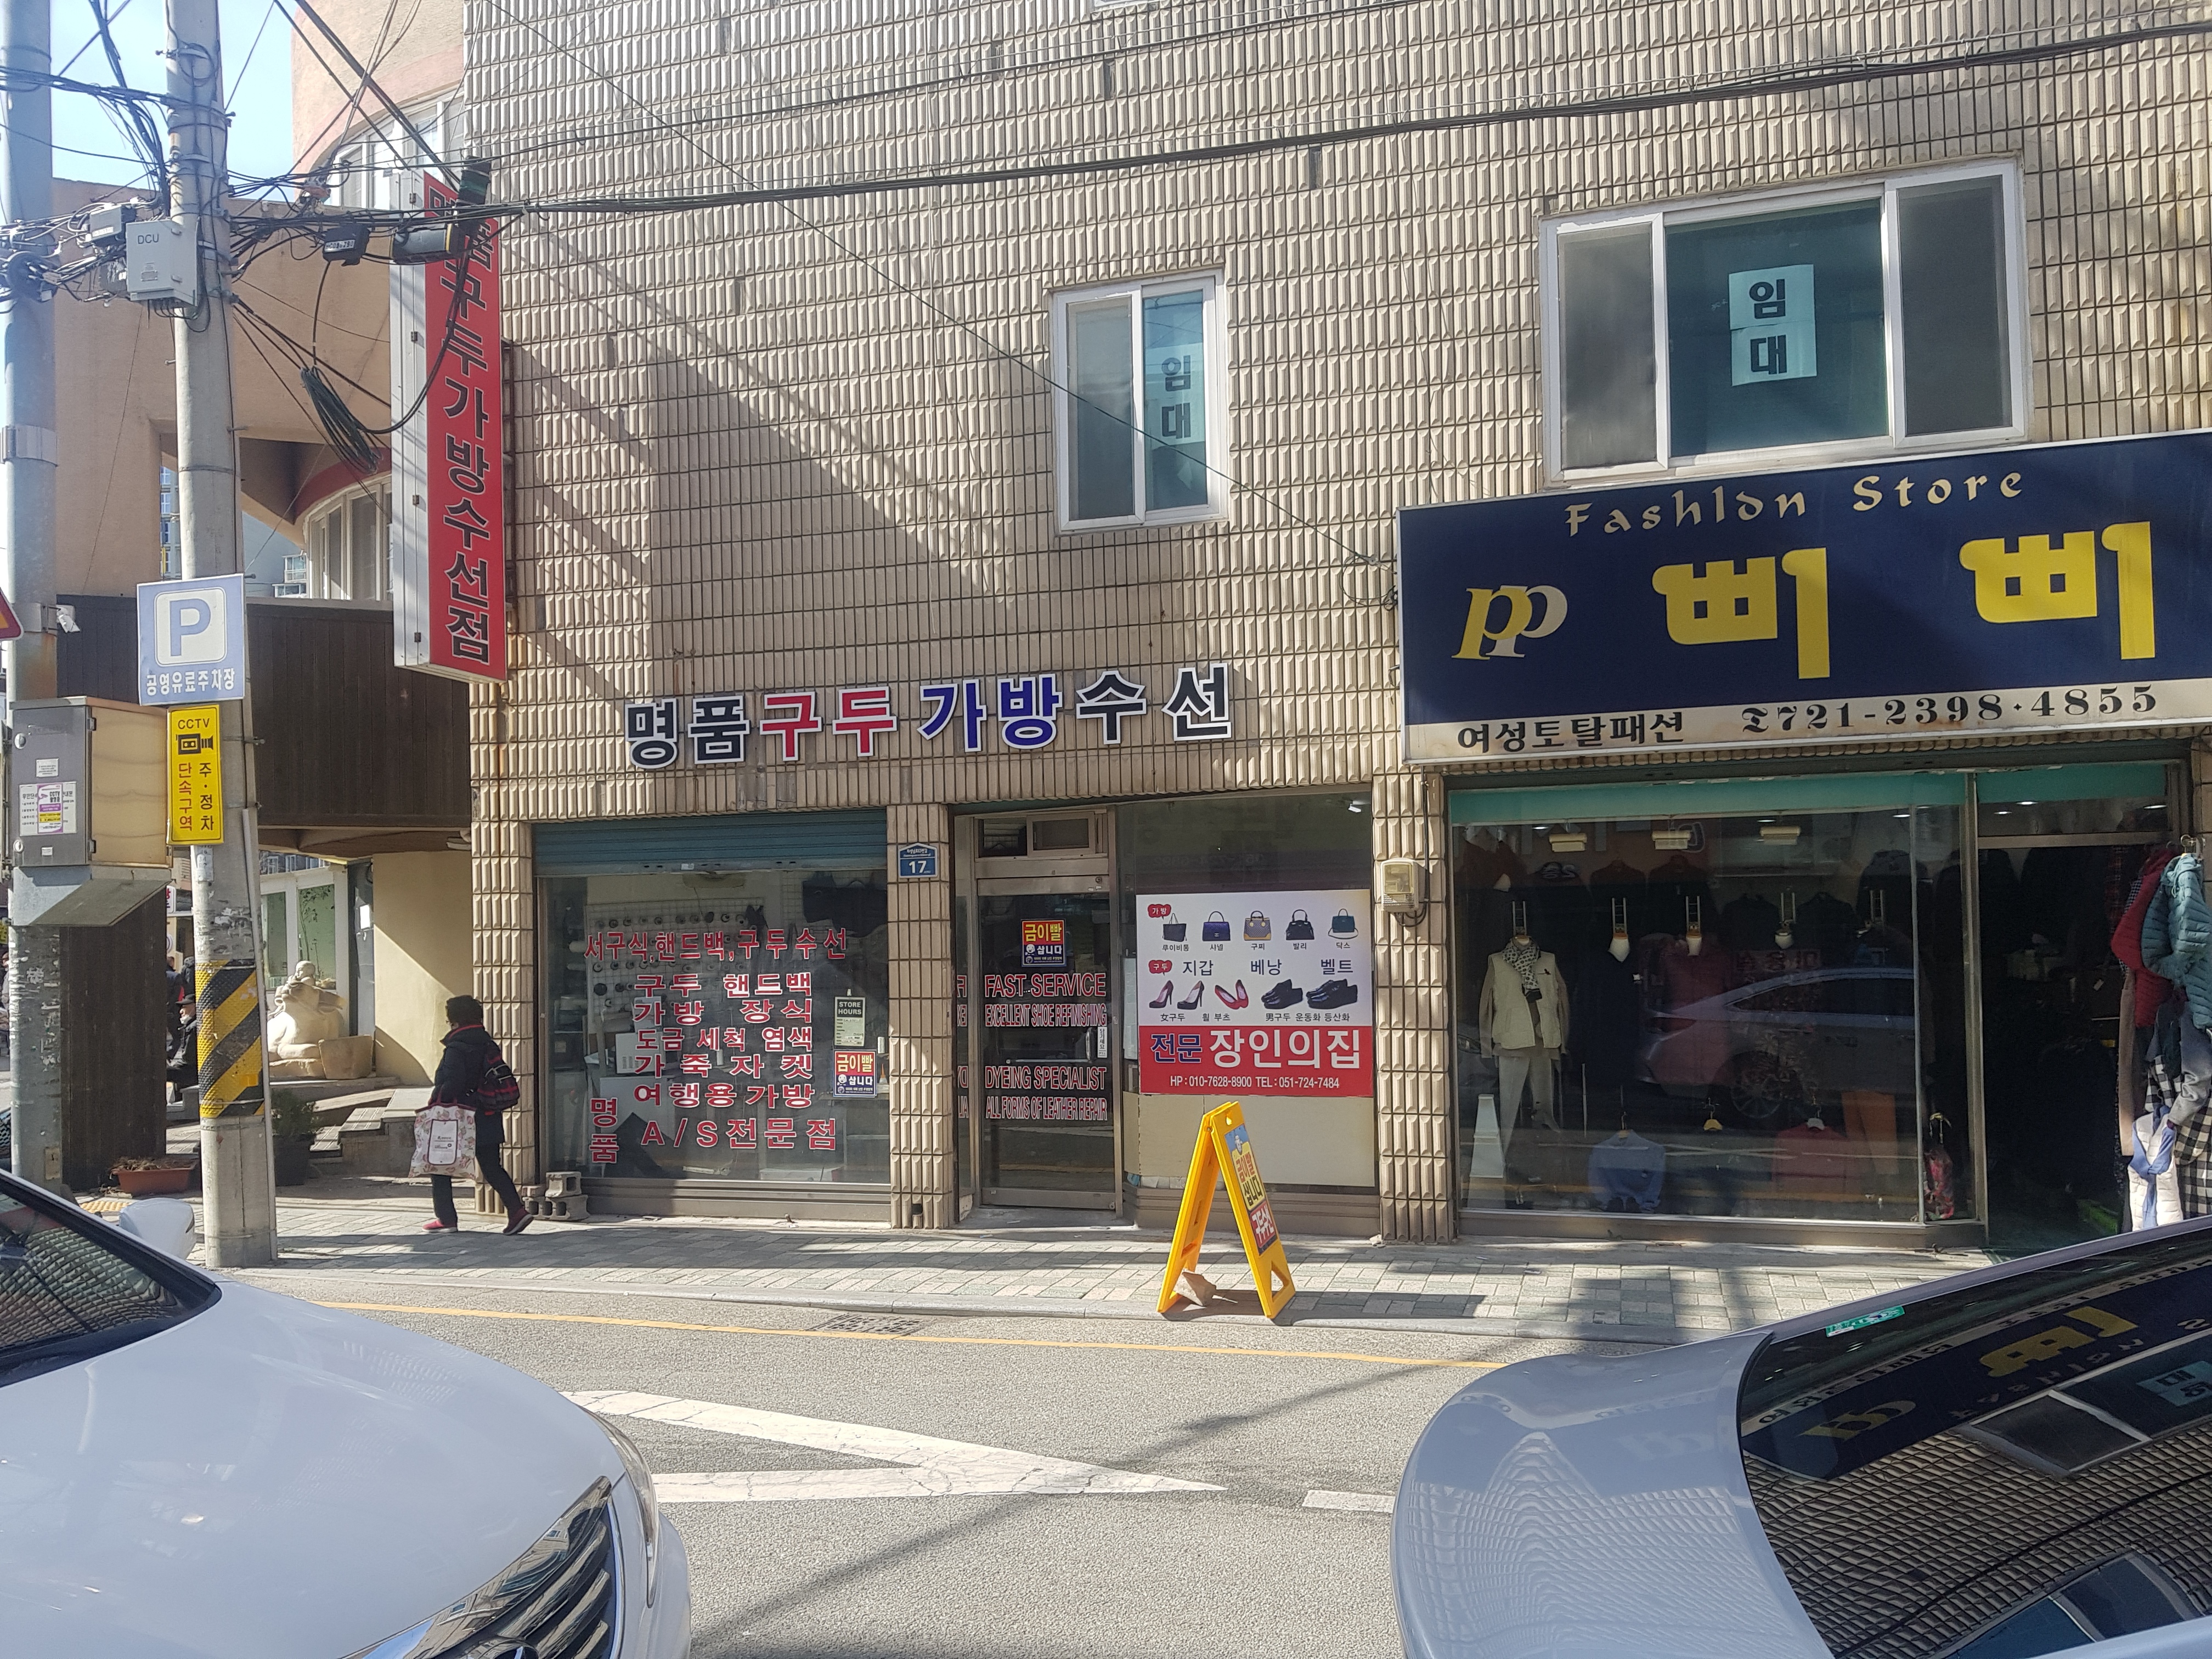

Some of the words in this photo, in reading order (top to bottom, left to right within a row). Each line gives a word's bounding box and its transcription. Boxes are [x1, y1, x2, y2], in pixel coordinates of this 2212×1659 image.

[137, 234, 159, 244] DCU
[1749, 279, 1787, 375] 임대
[1161, 355, 1191, 439] 임대
[1852, 472, 2022, 511] Store
[169, 599, 211, 656] P
[146, 668, 235, 696] 공영유료주차장
[177, 718, 210, 730] CCTV
[1457, 711, 1684, 756] 여성토탈패션
[178, 762, 193, 831] 단속구역
[909, 860, 927, 873] 17
[1024, 923, 1062, 942] 금이빨
[1036, 945, 1062, 955] 삽니다
[1182, 960, 1214, 976] 지갑
[1251, 959, 1282, 975] 베낭
[1321, 958, 1353, 975] 벨트
[634, 973, 702, 998] 구두
[723, 972, 812, 998] 핸드백
[984, 974, 1026, 997] FAST
[1031, 973, 1107, 997] SERVICE
[633, 1001, 705, 1026] 가방
[740, 998, 812, 1024] 장식
[985, 1003, 1031, 1028] EXCELLENT
[1031, 1003, 1054, 1027] SHOE
[1055, 1003, 1107, 1027] REFINISHING
[1214, 1013, 1231, 1022] 부츠
[1295, 1013, 1321, 1022] 운동화
[1324, 1013, 1350, 1022] 등산화
[635, 1027, 685, 1051] 도금
[696, 1026, 746, 1052] 세척
[761, 1026, 812, 1052] 염색
[1150, 1033, 1203, 1063] 전문
[1209, 1029, 1360, 1069] 장인의집
[837, 1054, 873, 1073] 금이빨
[848, 1076, 873, 1086] 삽니다
[985, 1065, 1031, 1089] DYEING
[1033, 1066, 1107, 1090] SPECIALIST
[986, 1096, 1001, 1119] ALL
[1002, 1096, 1030, 1119] FORMS
[1031, 1096, 1042, 1119] OF
[1043, 1097, 1078, 1120] LEATHER
[1079, 1097, 1107, 1121] REPAIR
[1235, 1152, 1255, 1183] 금이빨
